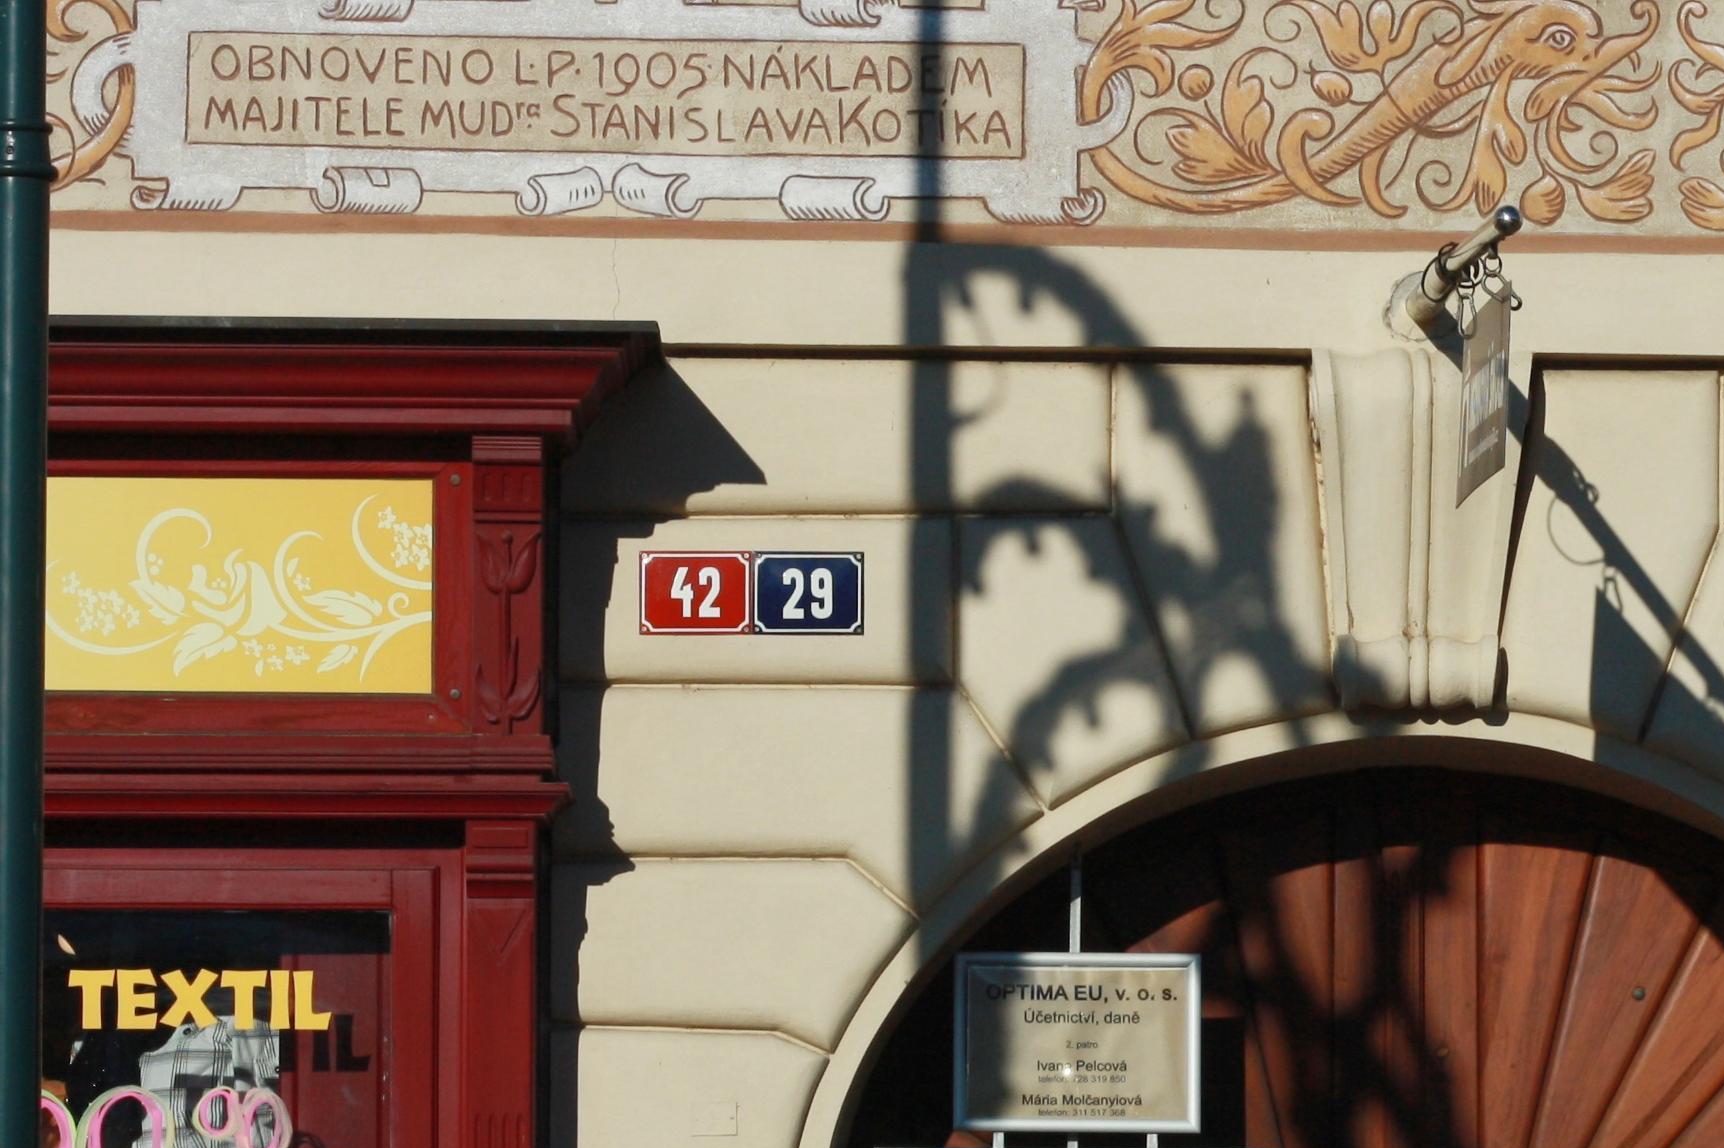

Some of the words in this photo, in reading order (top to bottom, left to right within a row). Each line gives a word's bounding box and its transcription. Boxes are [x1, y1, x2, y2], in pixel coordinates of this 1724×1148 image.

[210, 44, 494, 86] OBNOVENO
[723, 45, 992, 97] NÁKLADEM
[204, 95, 406, 137] MAJITELE
[550, 93, 832, 145] STANISLAVA
[838, 96, 1012, 149] KOTÍKA
[670, 566, 721, 618] 42
[782, 567, 833, 620] 29
[68, 968, 332, 1030] TEXTIL
[986, 984, 1068, 1001] OPTIMA
[1074, 984, 1108, 1003] EU,
[1115, 988, 1130, 1001] v.
[1137, 988, 1155, 1002] o.
[1162, 988, 1178, 1001] s.
[1024, 1008, 1099, 1026] Účetnictví,
[1104, 1011, 1141, 1025] daně
[1076, 1040, 1098, 1051] patro
[1076, 1060, 1127, 1072] Pelcová
[1021, 1093, 1058, 1106] Mária
[1062, 1093, 1142, 1108] Molčanyiová
